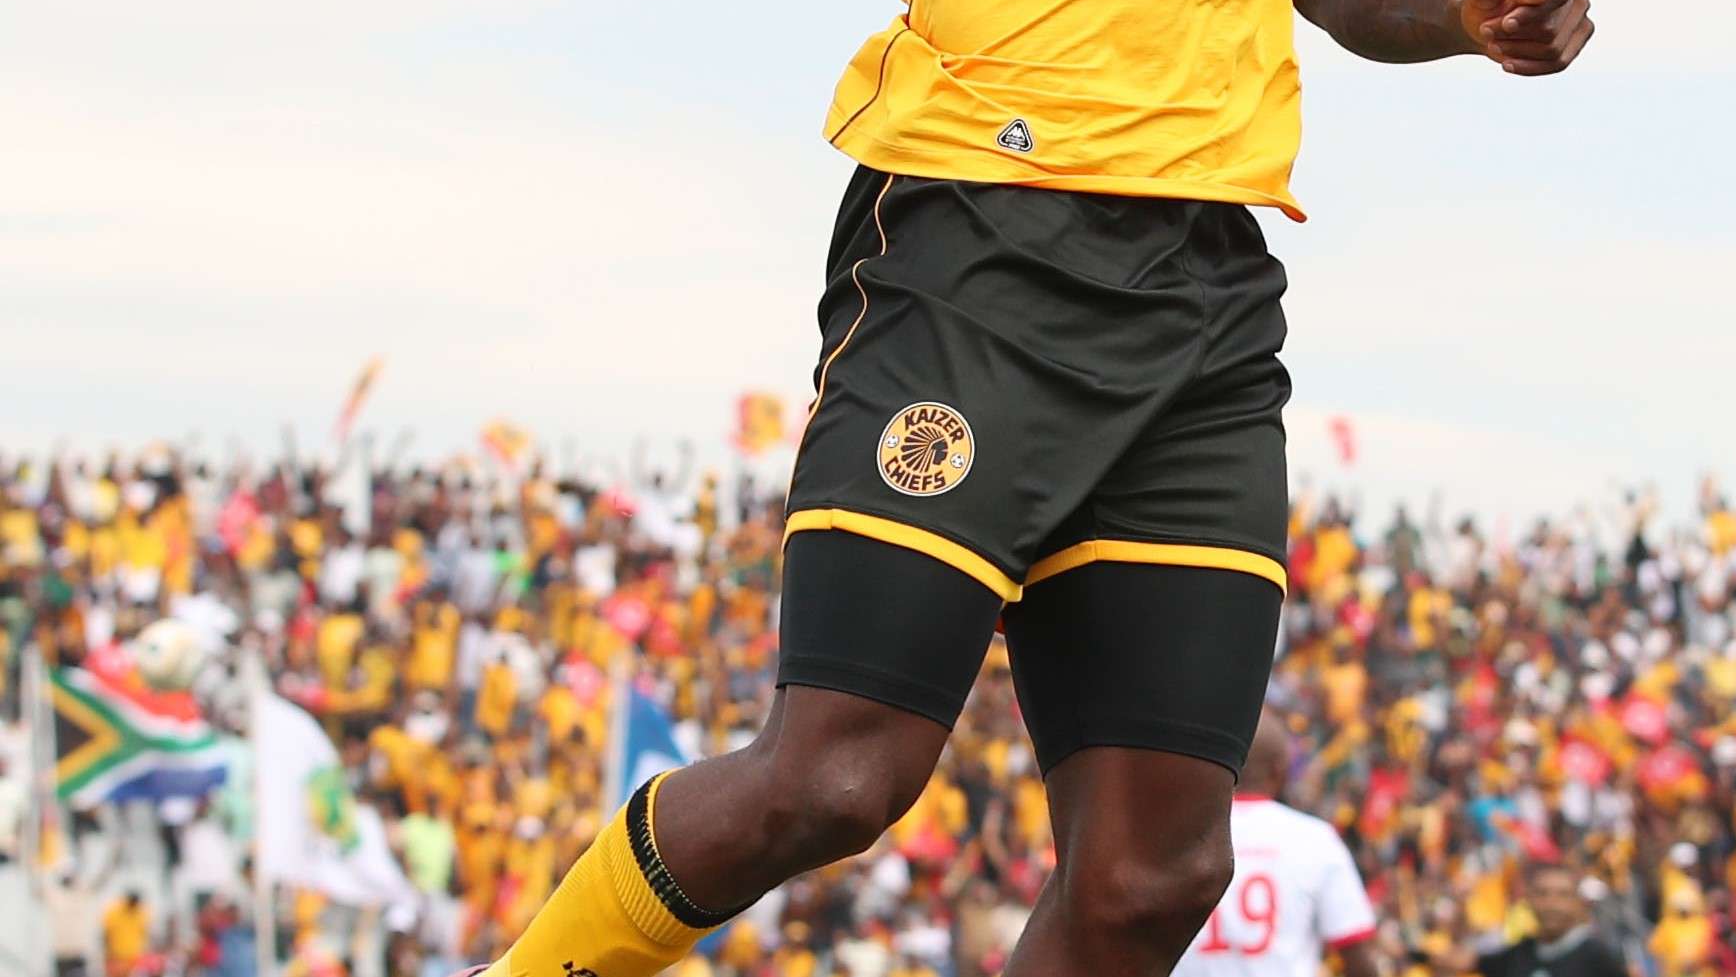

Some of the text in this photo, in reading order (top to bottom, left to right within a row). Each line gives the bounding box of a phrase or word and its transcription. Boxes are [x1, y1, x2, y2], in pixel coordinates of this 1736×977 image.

[904, 408, 965, 444] KAIZER
[884, 456, 947, 491] CHIEFS
[1199, 872, 1277, 955] 19
